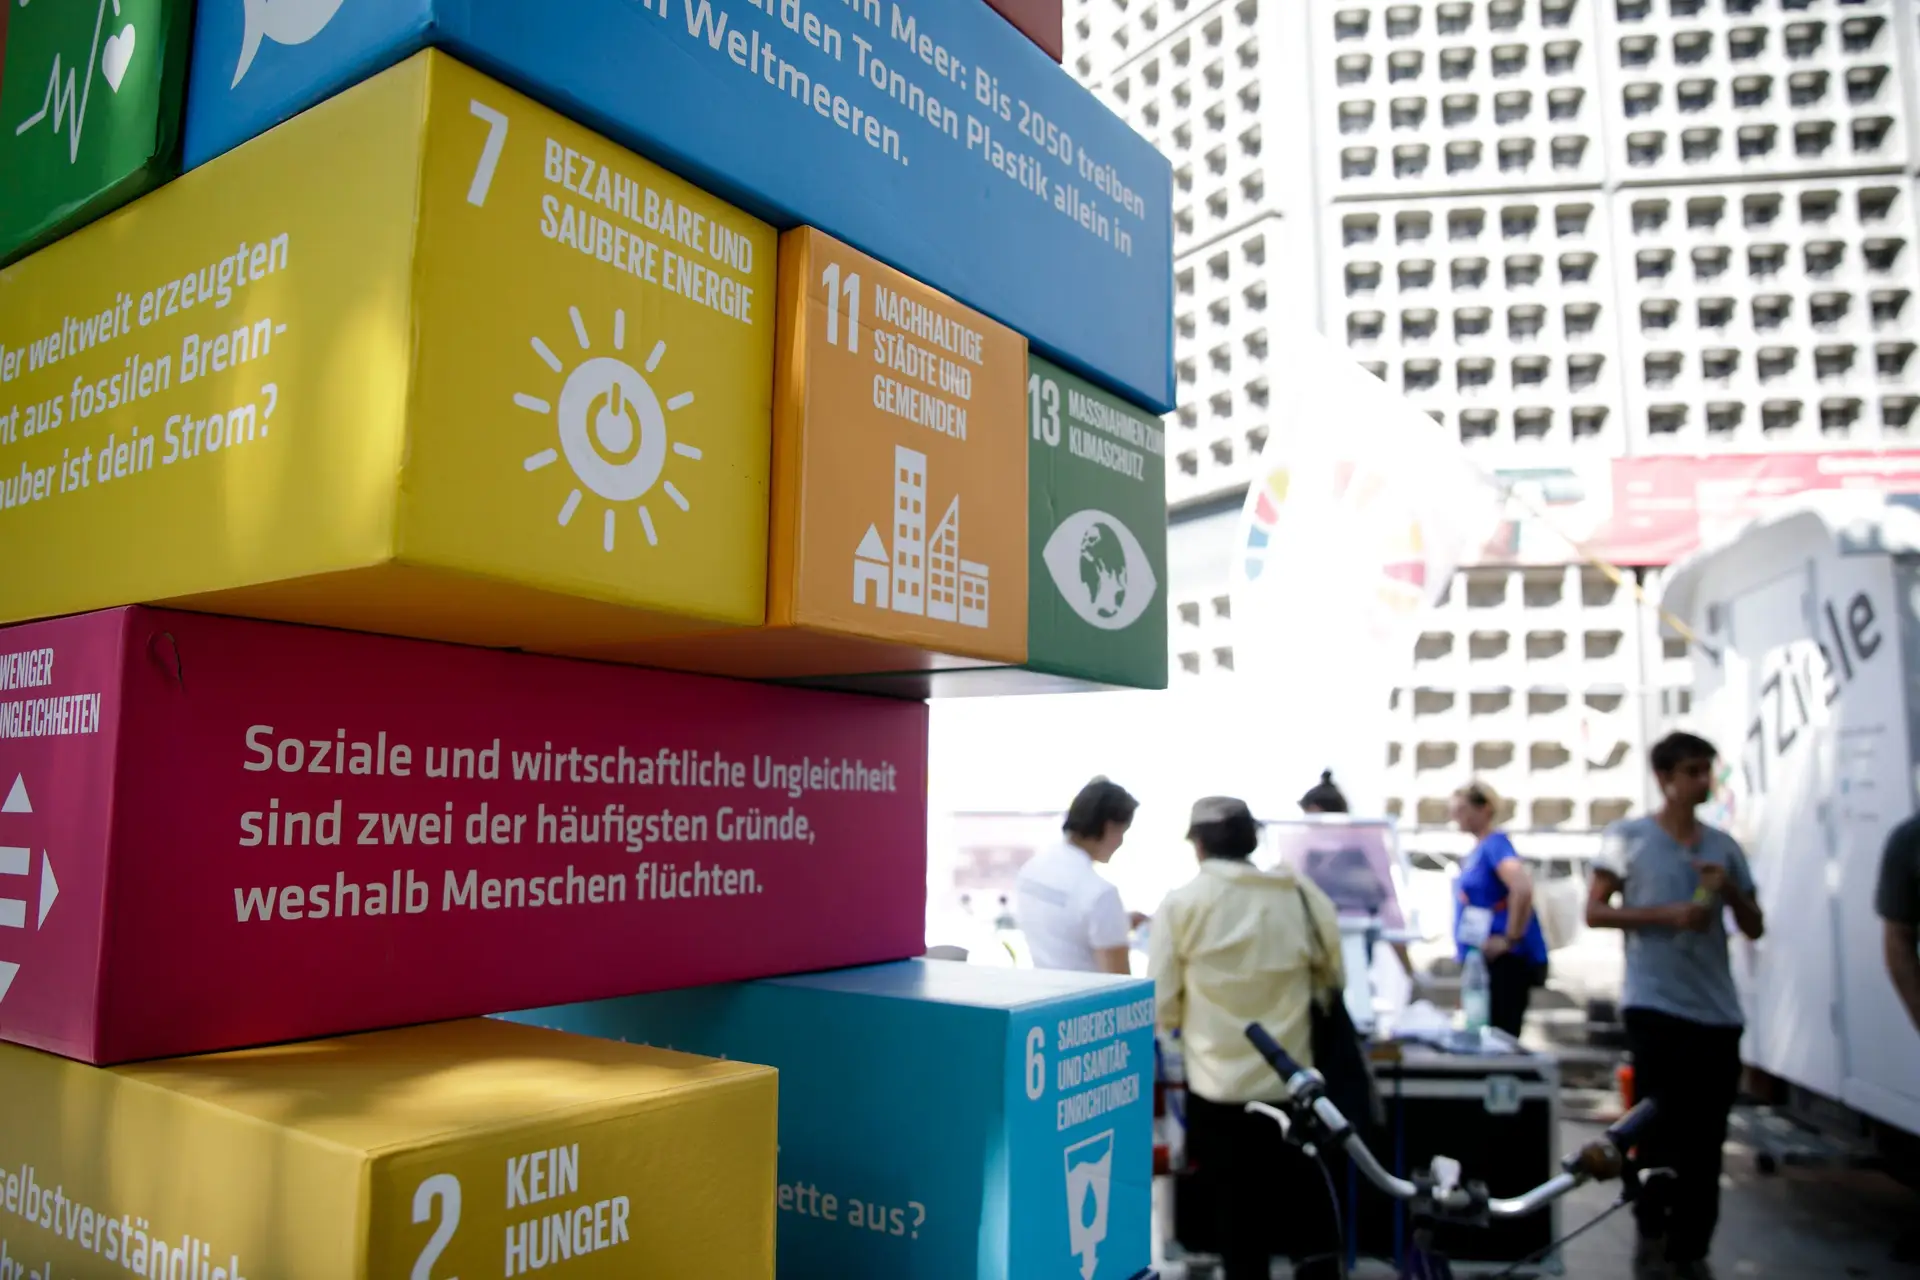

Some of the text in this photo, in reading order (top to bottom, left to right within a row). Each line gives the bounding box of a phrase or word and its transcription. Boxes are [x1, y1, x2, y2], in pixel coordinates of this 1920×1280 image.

[684, 0, 909, 166] Weltmeeren.
[891, 3, 967, 90] Meer:
[975, 65, 1011, 122] Bis
[1018, 100, 1073, 166] 2050
[1077, 147, 1145, 220] treiben
[467, 98, 509, 208] 7
[852, 33, 958, 140] Tonnen
[967, 114, 1048, 200] Plastik
[1054, 183, 1110, 242] allein
[1114, 216, 1132, 257] in
[544, 137, 753, 274] BEZAHLBARE UND
[540, 194, 753, 325] SAUBERE ENERGIE
[29, 292, 133, 372] weltweit
[138, 232, 289, 327] erzeugten
[822, 262, 860, 354] 11
[875, 283, 983, 366] NACHHALTIGE
[23, 395, 63, 438] aus
[70, 354, 171, 422] fossilen
[180, 317, 287, 384] Brenn-
[873, 328, 972, 400] STÄDTE UND
[60, 448, 92, 493] ist
[97, 427, 155, 483] dein
[162, 382, 278, 464] Strom?
[873, 374, 967, 441] GEMEINDEN
[1028, 373, 1061, 447] 13
[1068, 389, 1145, 449] MASSNAHMEN
[1068, 424, 1144, 481] KLIMASCHUTZ
[0, 648, 54, 691] WENIGER
[0, 692, 101, 738] NGLEICHHEITEN
[243, 724, 896, 798] Soziale und wirtschaftliche Ungleichheit
[238, 798, 816, 852] sind zwei der häufigsten Gründe,
[233, 861, 763, 922] weshalb Menschen flüchten.
[1025, 1026, 1046, 1100] 6
[1057, 1008, 1115, 1052] SAUBERES
[1057, 1039, 1132, 1091] UND SANITÄR-
[1057, 1072, 1140, 1132] EINRICHTUNGEN
[506, 1143, 579, 1210] KEIN
[410, 1173, 462, 1280] 2
[505, 1195, 630, 1278] HUNGER
[848, 1198, 926, 1240] aus?
